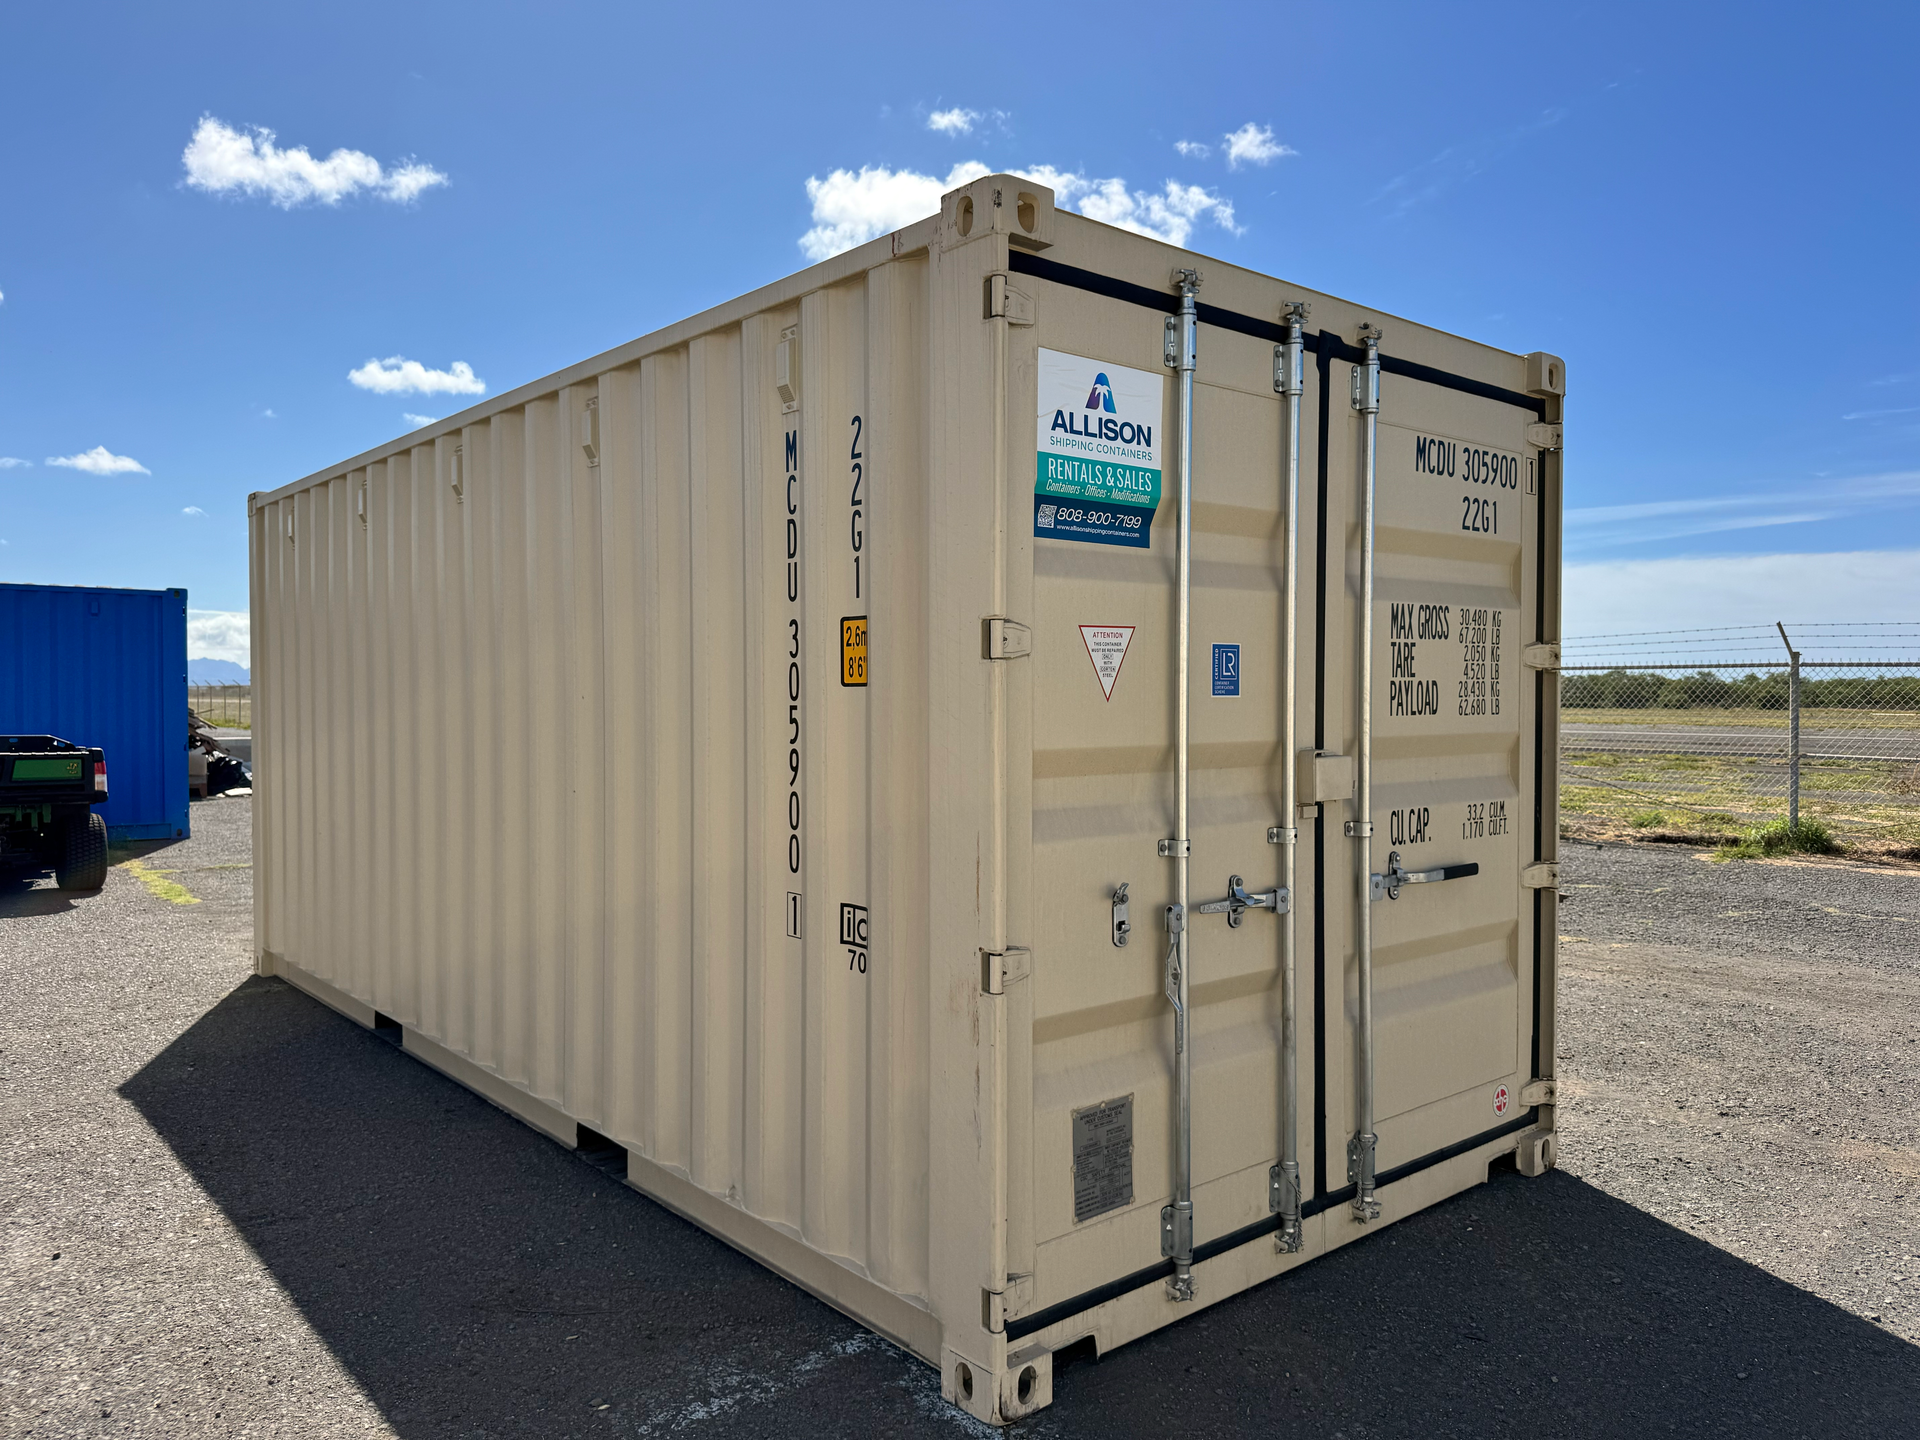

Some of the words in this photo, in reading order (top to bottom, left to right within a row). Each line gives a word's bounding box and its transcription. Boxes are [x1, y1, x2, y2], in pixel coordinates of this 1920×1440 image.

[1051, 409, 1152, 448] ALLISON
[1050, 435, 1094, 452] SHIPPING
[1096, 443, 1153, 462] CONTAINERS
[1415, 435, 1456, 478] MCDU
[1462, 447, 1518, 490] 305900
[1046, 479, 1080, 495] Containers
[1084, 484, 1106, 498] Offices
[1110, 489, 1150, 504] Modifications
[1048, 457, 1103, 485] RENTALS
[1106, 466, 1115, 487] &
[1116, 468, 1152, 492] SALES
[785, 430, 798, 602] MCDU
[850, 415, 863, 599] 22G1
[1057, 507, 1141, 529] 808-900-7199
[1461, 496, 1498, 534] 22G1
[1056, 525, 1140, 538] www.allisonshippingcontainers.com
[1092, 631, 1123, 639] ATTENTION
[1390, 603, 1414, 640] MAX
[1417, 604, 1450, 640] GROSS
[1491, 610, 1502, 628] KG
[1491, 628, 1500, 645] LB
[1223, 652, 1236, 675] LR
[1390, 641, 1416, 678] TARE
[1490, 646, 1500, 662] KG
[1490, 663, 1500, 680] LB
[1390, 680, 1439, 717] PAYLOAD
[1490, 681, 1500, 698] KG
[1490, 698, 1500, 715] LB
[789, 618, 800, 874] 305900
[1390, 809, 1406, 846] CU.
[1408, 807, 1432, 844] CAP.
[1466, 803, 1484, 821] 33.2
[791, 895, 798, 936] 1
[847, 948, 867, 974] 70
